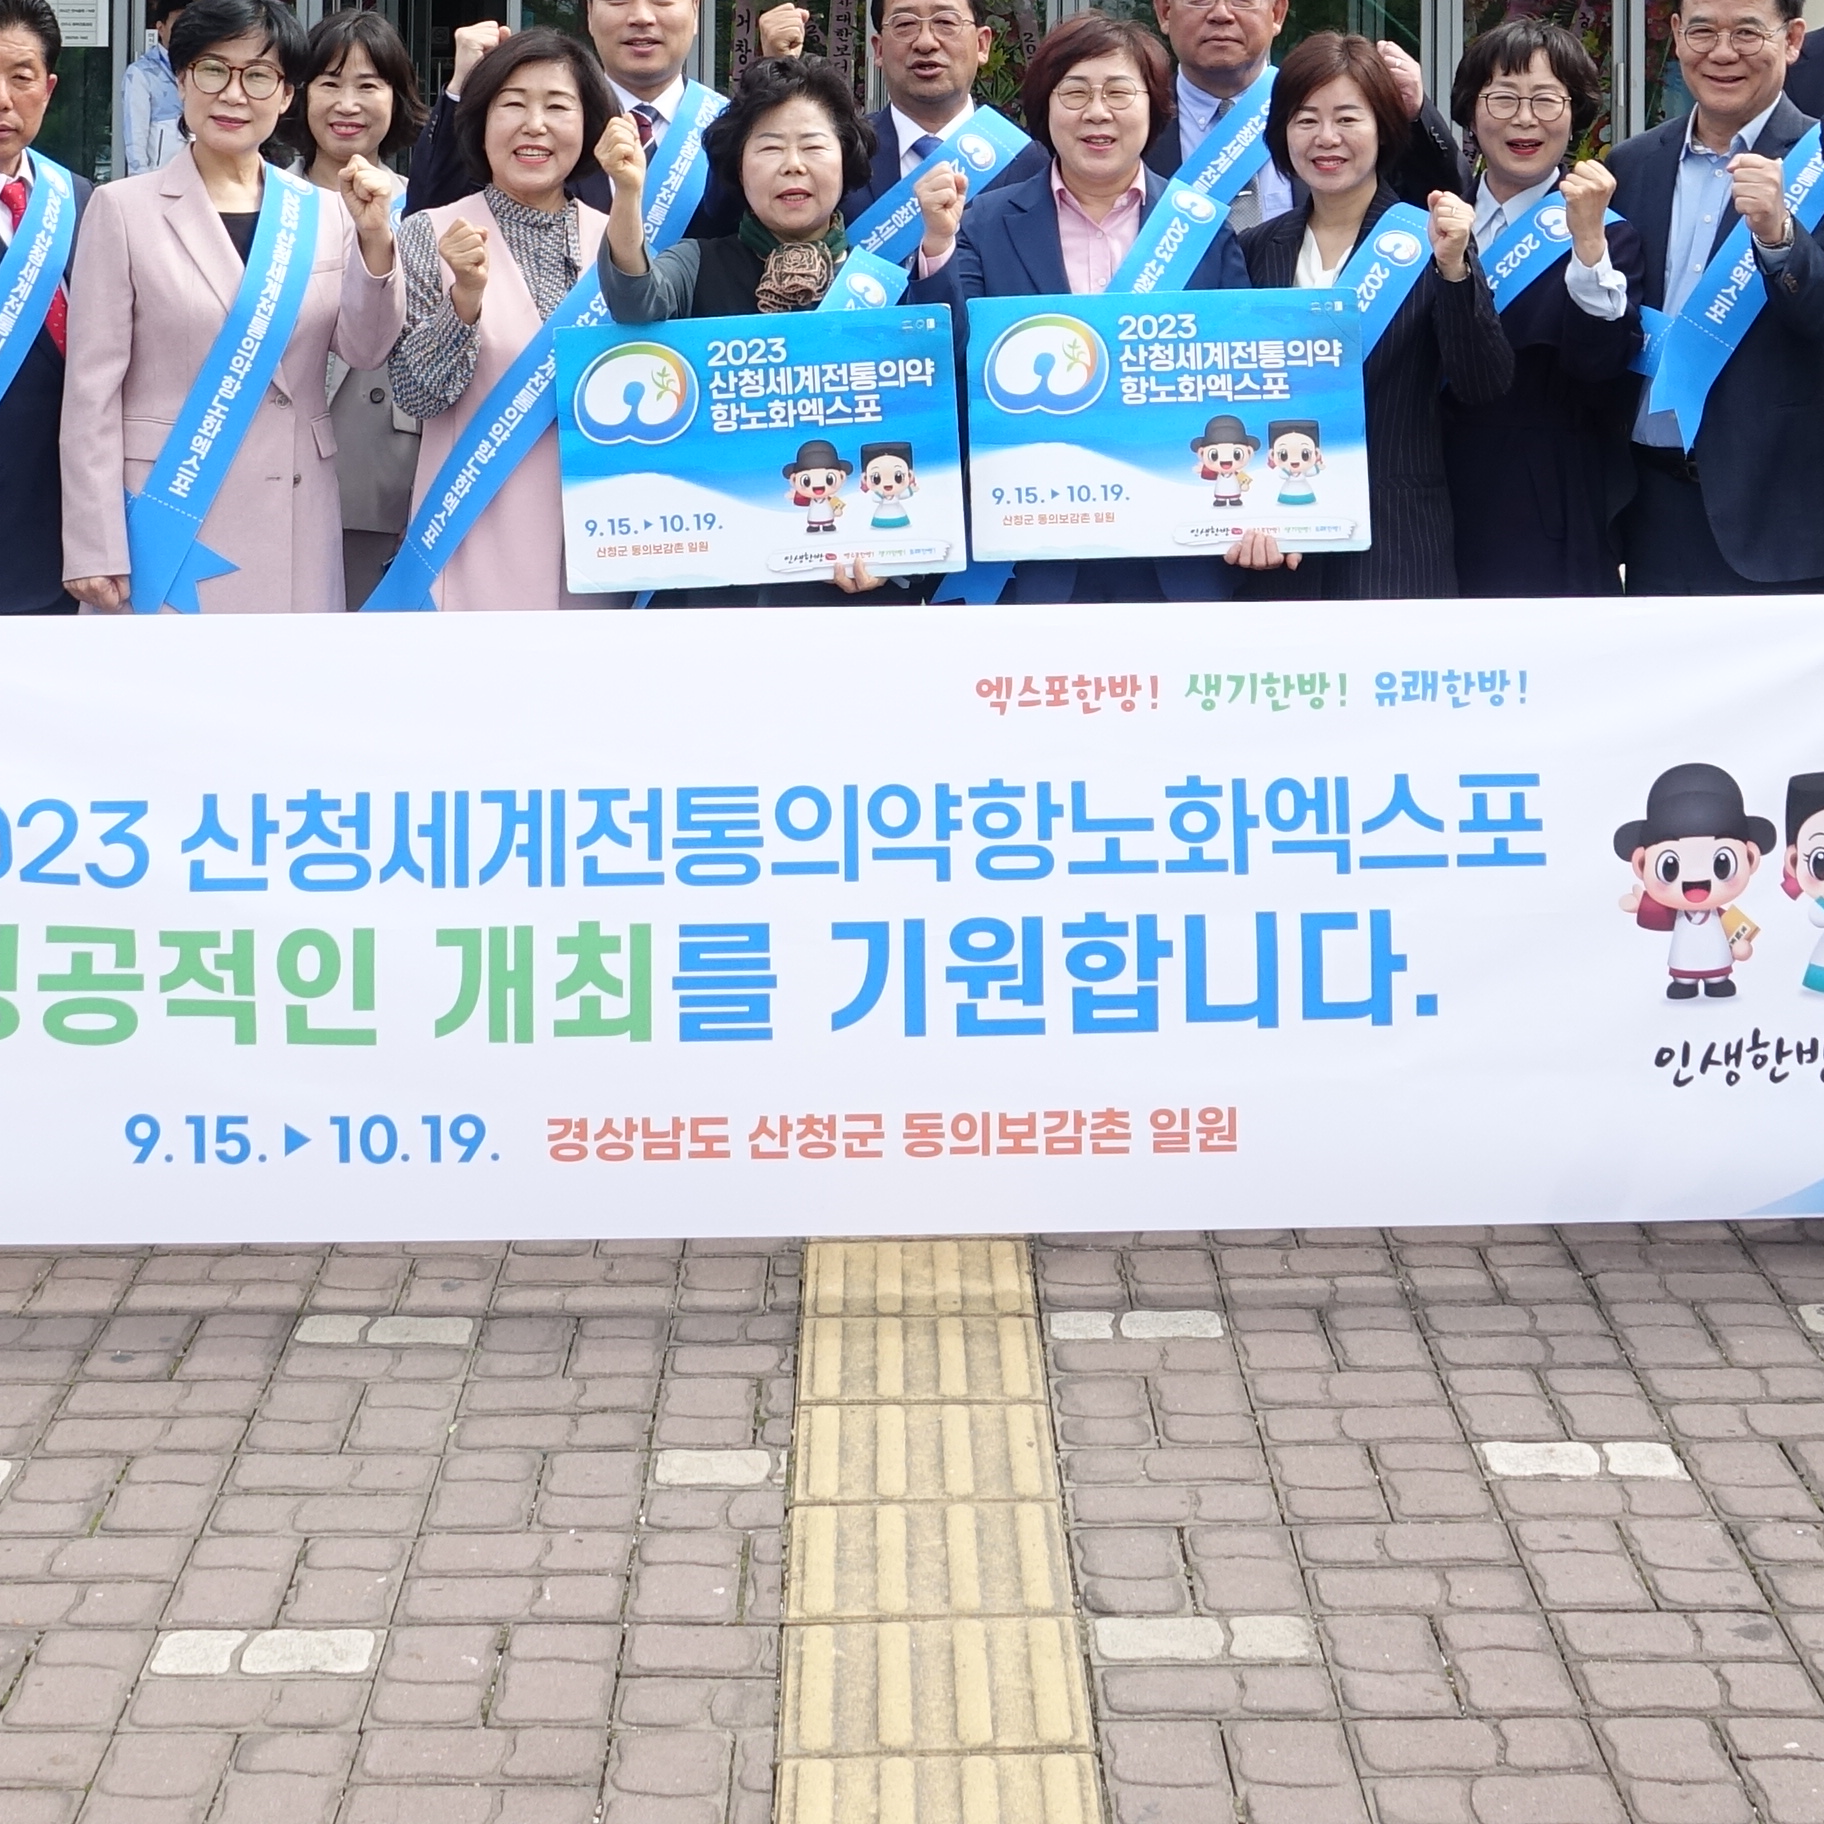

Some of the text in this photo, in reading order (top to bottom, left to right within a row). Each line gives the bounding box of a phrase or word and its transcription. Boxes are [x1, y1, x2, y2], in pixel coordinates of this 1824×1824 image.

[44, 189, 68, 232] 2023
[276, 192, 301, 235] 2023
[1160, 211, 1192, 261] 2023
[1493, 230, 1542, 279] 2023
[1117, 313, 1197, 341] 2023
[706, 337, 788, 367] 2023
[1118, 339, 1343, 373] 산청세계전통의약
[708, 357, 936, 401] 산청세계전통의약
[1119, 374, 1291, 406] 항노화엑스포
[711, 395, 883, 435] 항노화엑스포
[991, 482, 1131, 506] 9.15. 10.19.
[584, 512, 724, 537] 9.15. 10.19.
[1001, 510, 1116, 526] 산청군 동의보감촌 일원
[595, 540, 710, 558] 산청군 동의보감촌 일원
[975, 666, 1530, 717] 엑스포한방! 생기한방! 유쾌한방!
[179, 772, 1549, 893] 산청세계전통의약항노화엑스포
[434, 920, 778, 1046] 개최를
[829, 909, 1441, 1038] 기원합니다.
[124, 1105, 1239, 1166] 9.15. 10.19. 경상남도 산청군 동의보감촌 일원
